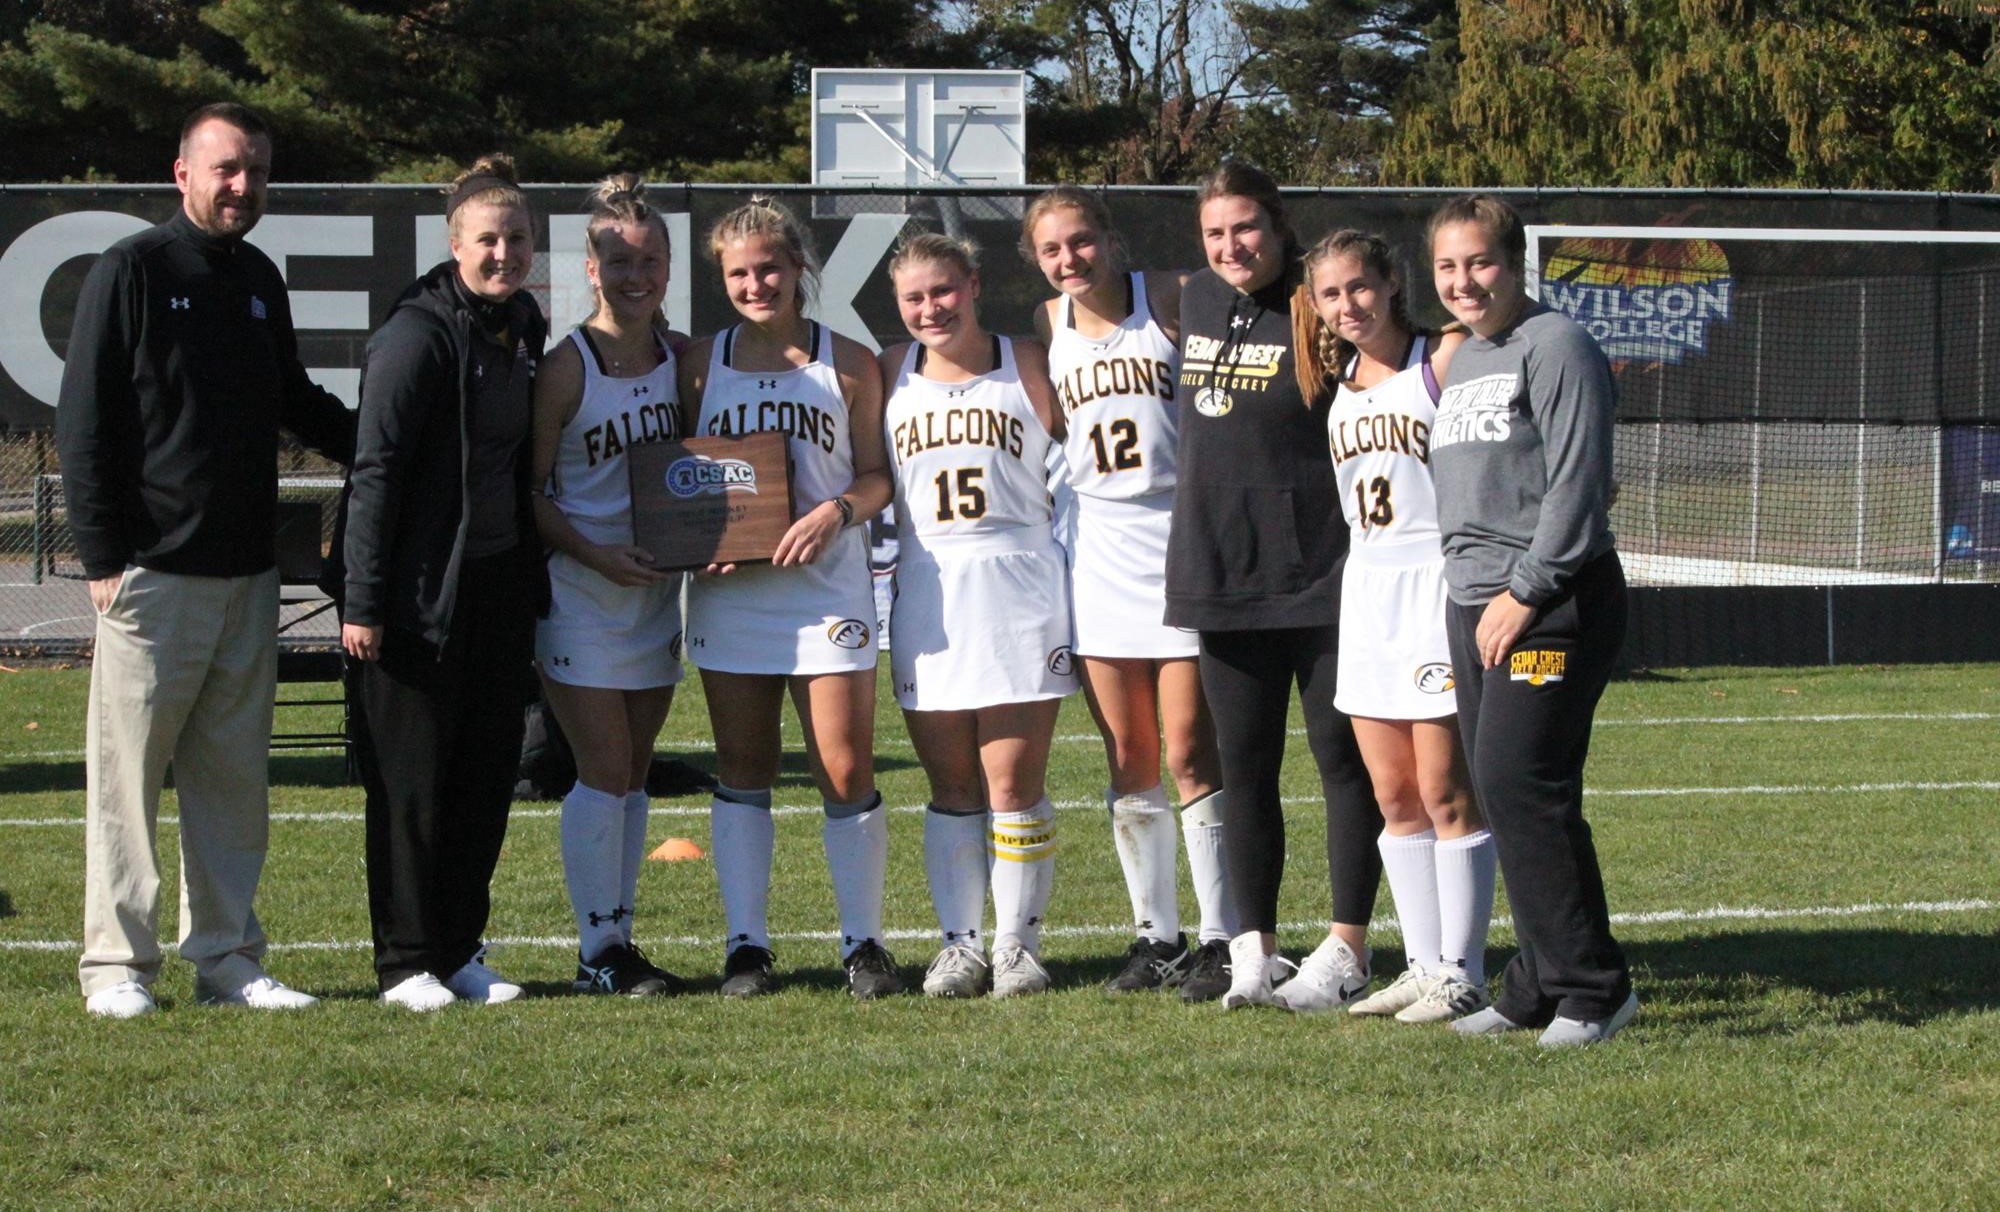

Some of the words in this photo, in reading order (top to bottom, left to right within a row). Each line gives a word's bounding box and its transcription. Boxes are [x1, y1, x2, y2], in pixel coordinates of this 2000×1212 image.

[1541, 283, 1730, 319] WILSON
[1577, 319, 1702, 347] OLLEGE
[1181, 374, 1205, 385] FIELD
[584, 402, 681, 467] FALCON
[895, 408, 1024, 465] FALCONS
[1089, 418, 1142, 474] 12
[1330, 413, 1429, 467] ALCONS
[695, 464, 753, 484] CSAC
[935, 467, 986, 521] 15
[1356, 475, 1394, 529] 13
[1510, 650, 1537, 666] CEDAR
[1540, 650, 1566, 666] CREST
[991, 832, 1050, 846] CAPTAIN
